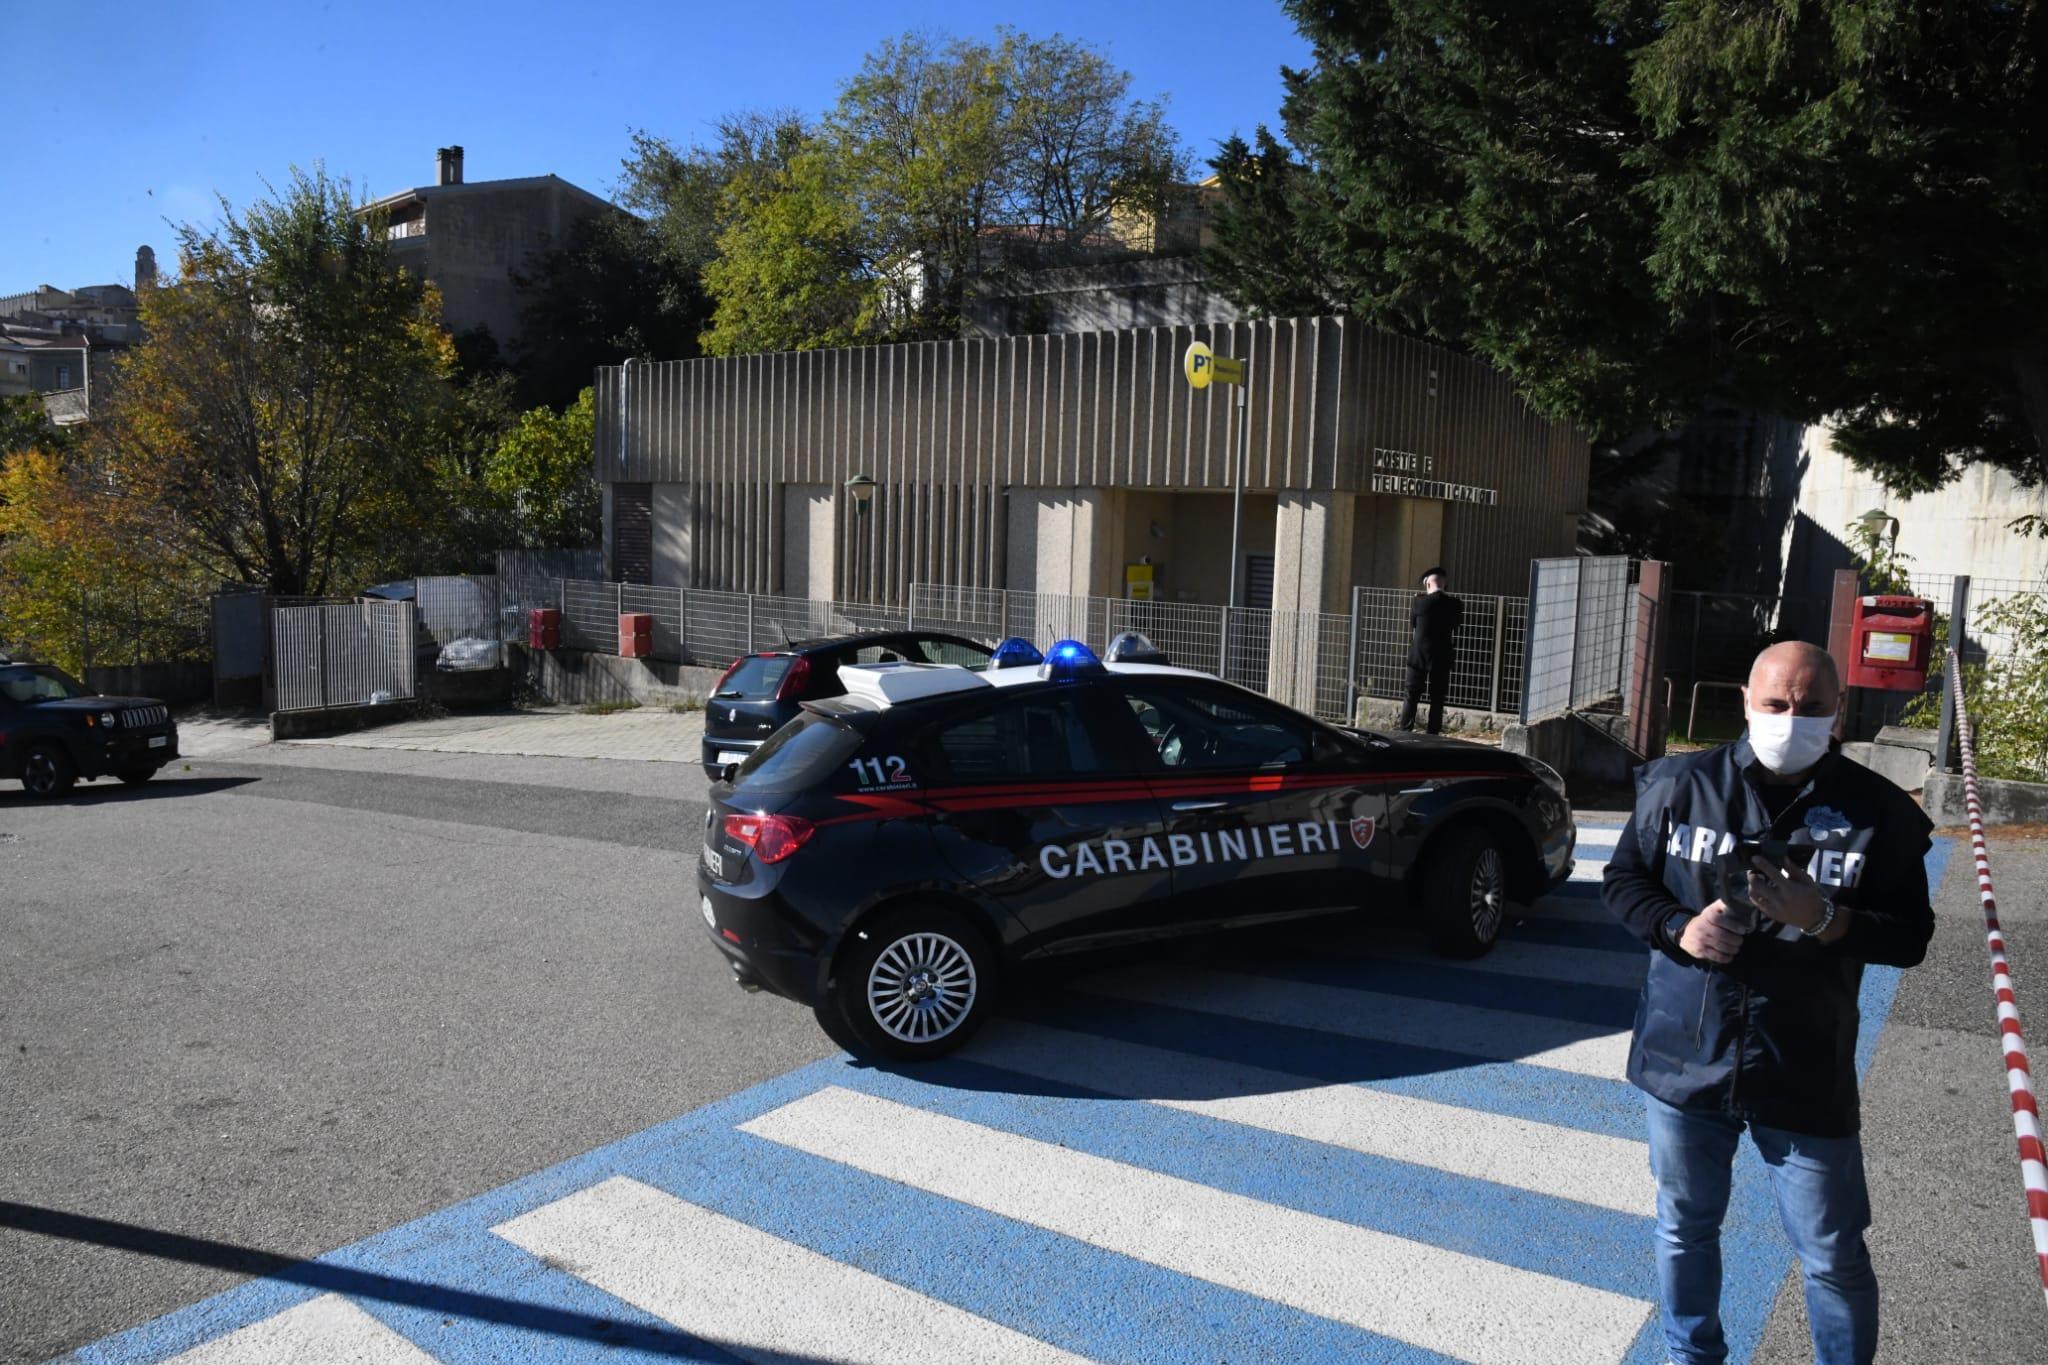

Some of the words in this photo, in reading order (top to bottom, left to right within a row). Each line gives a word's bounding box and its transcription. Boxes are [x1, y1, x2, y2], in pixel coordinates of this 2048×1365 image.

[1374, 447, 1416, 471] POSTE
[1424, 456, 1432, 473] E
[1372, 473, 1497, 506] TELECOMUNICAZIONI
[848, 755, 912, 785] 112
[1039, 819, 1341, 879] CARABINIERI
